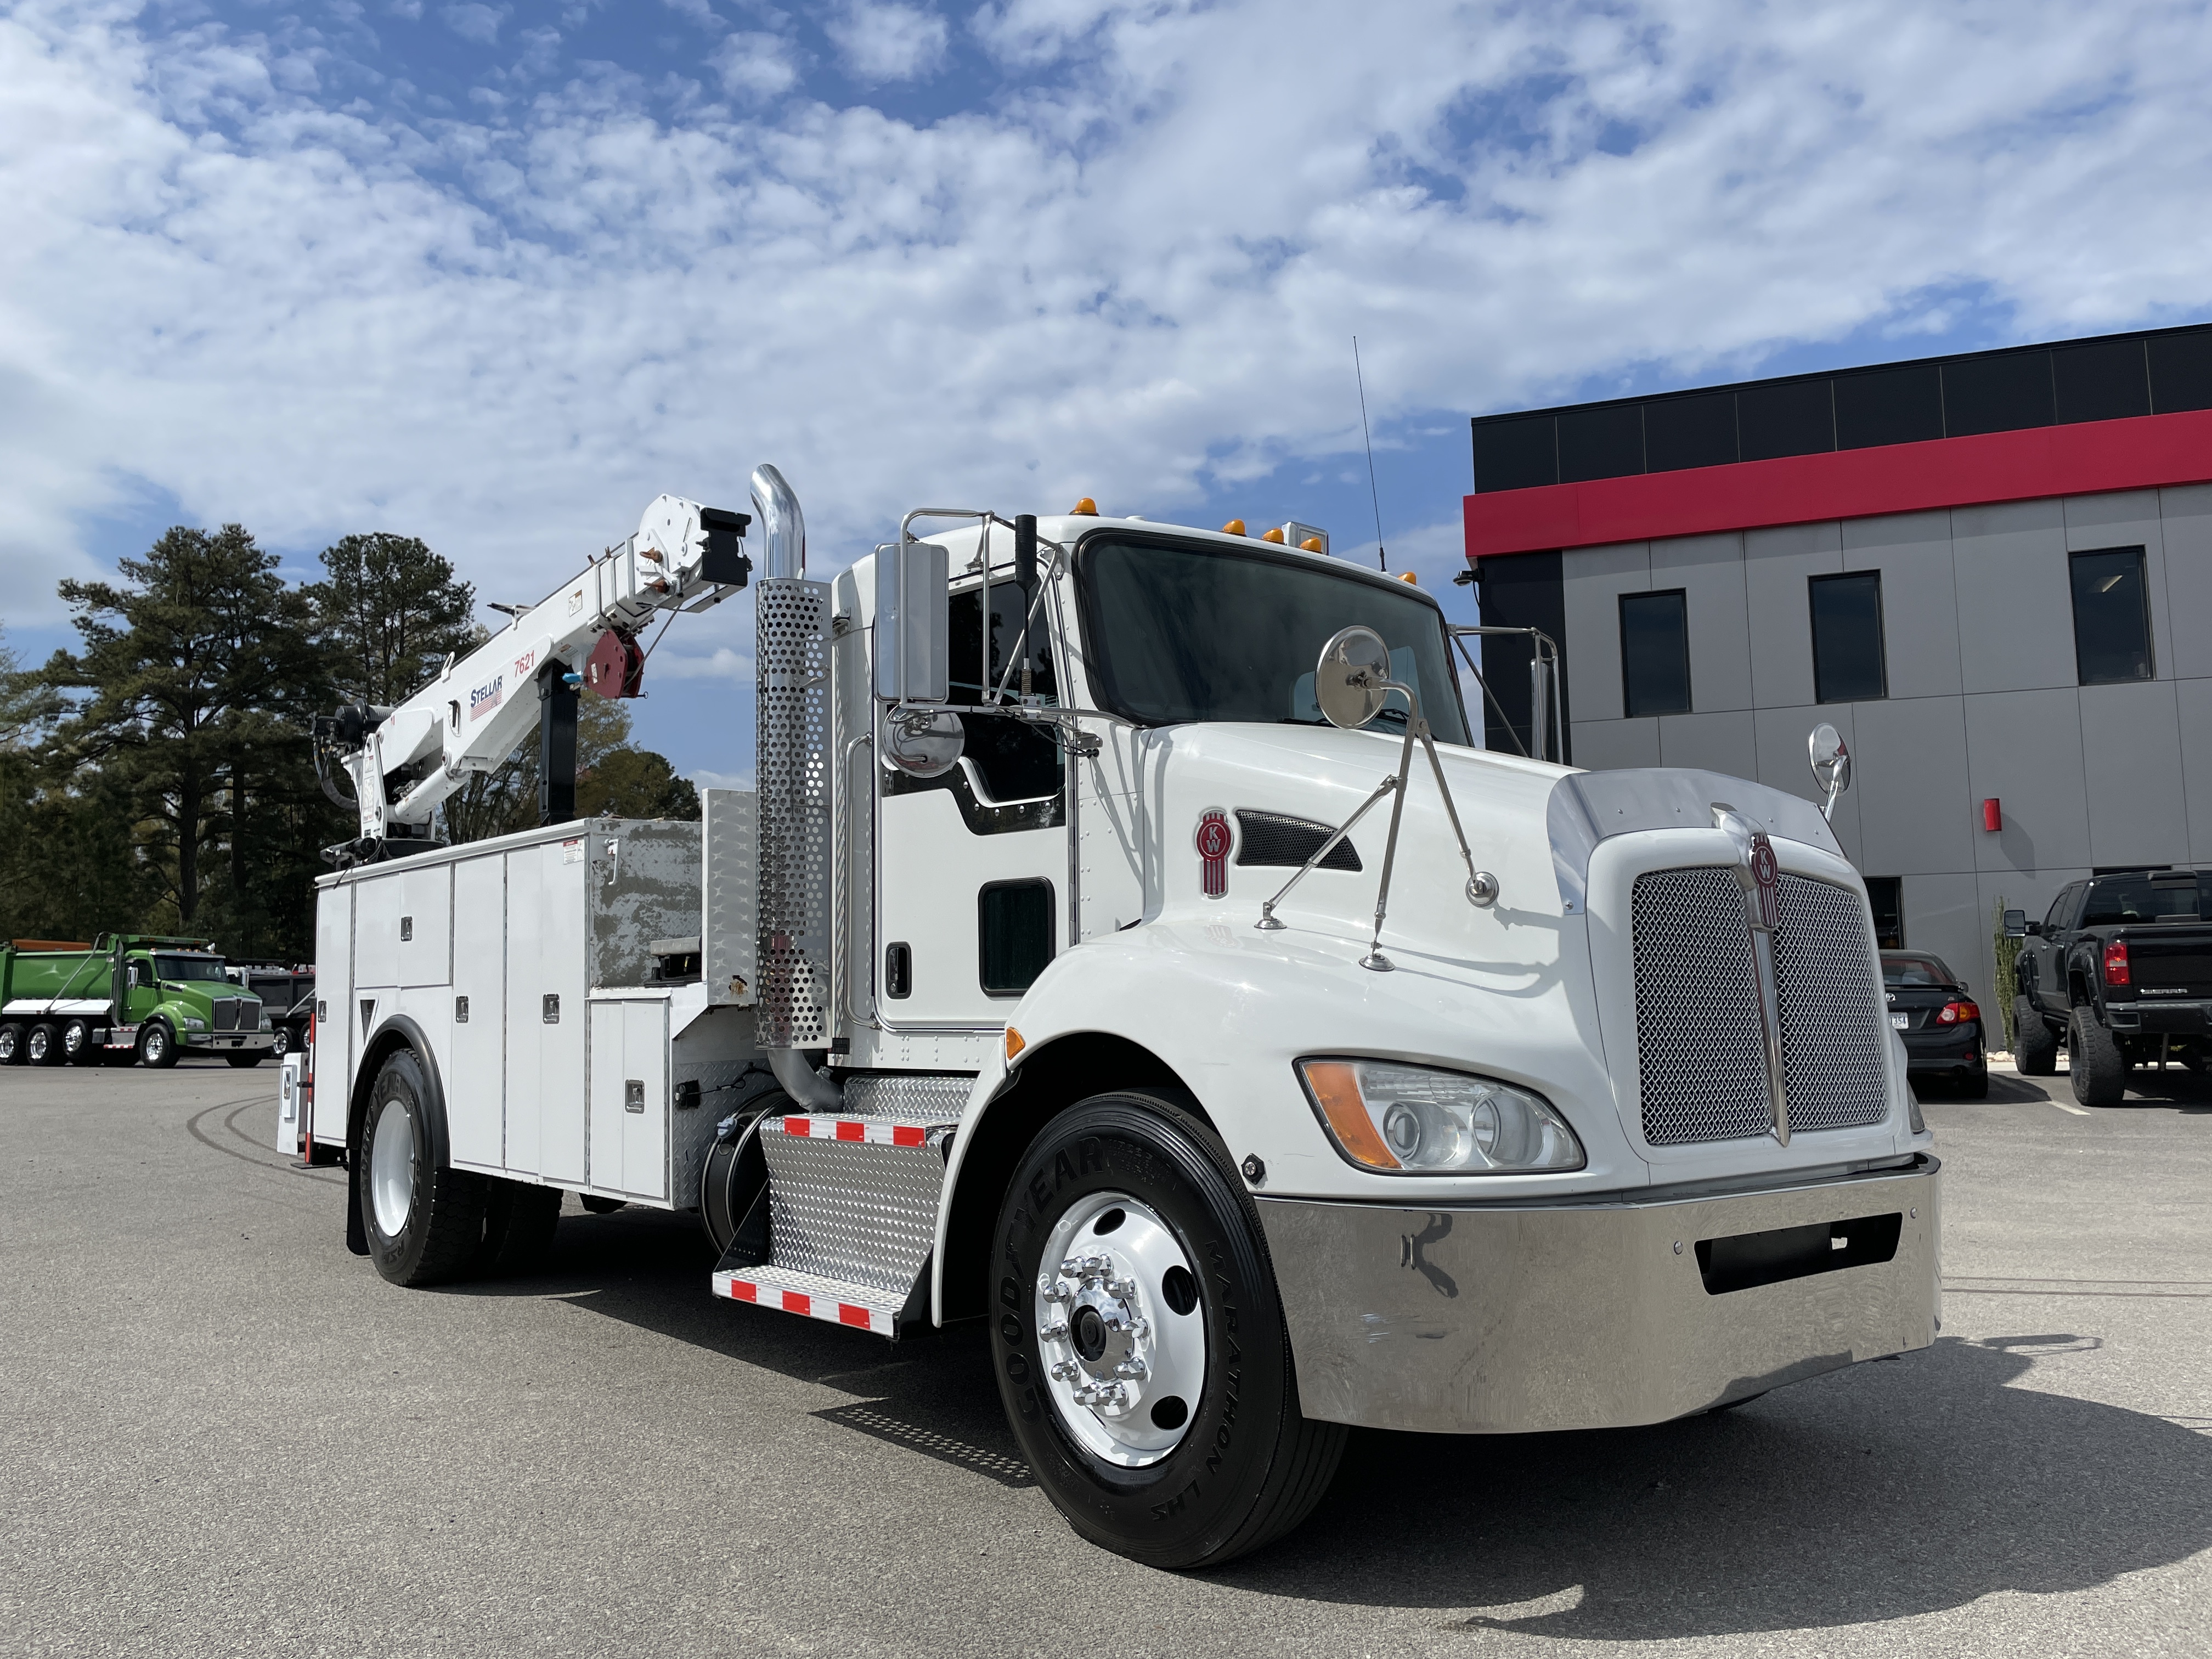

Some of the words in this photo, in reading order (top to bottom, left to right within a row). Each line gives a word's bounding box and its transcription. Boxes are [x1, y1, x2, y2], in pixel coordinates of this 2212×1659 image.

[515, 650, 534, 678] 7621
[471, 675, 503, 708] STELLAR
[1000, 1136, 1105, 1425] GOODYEAR
[1205, 1240, 1241, 1475] MARATHON
[1150, 1478, 1201, 1522] LHS
